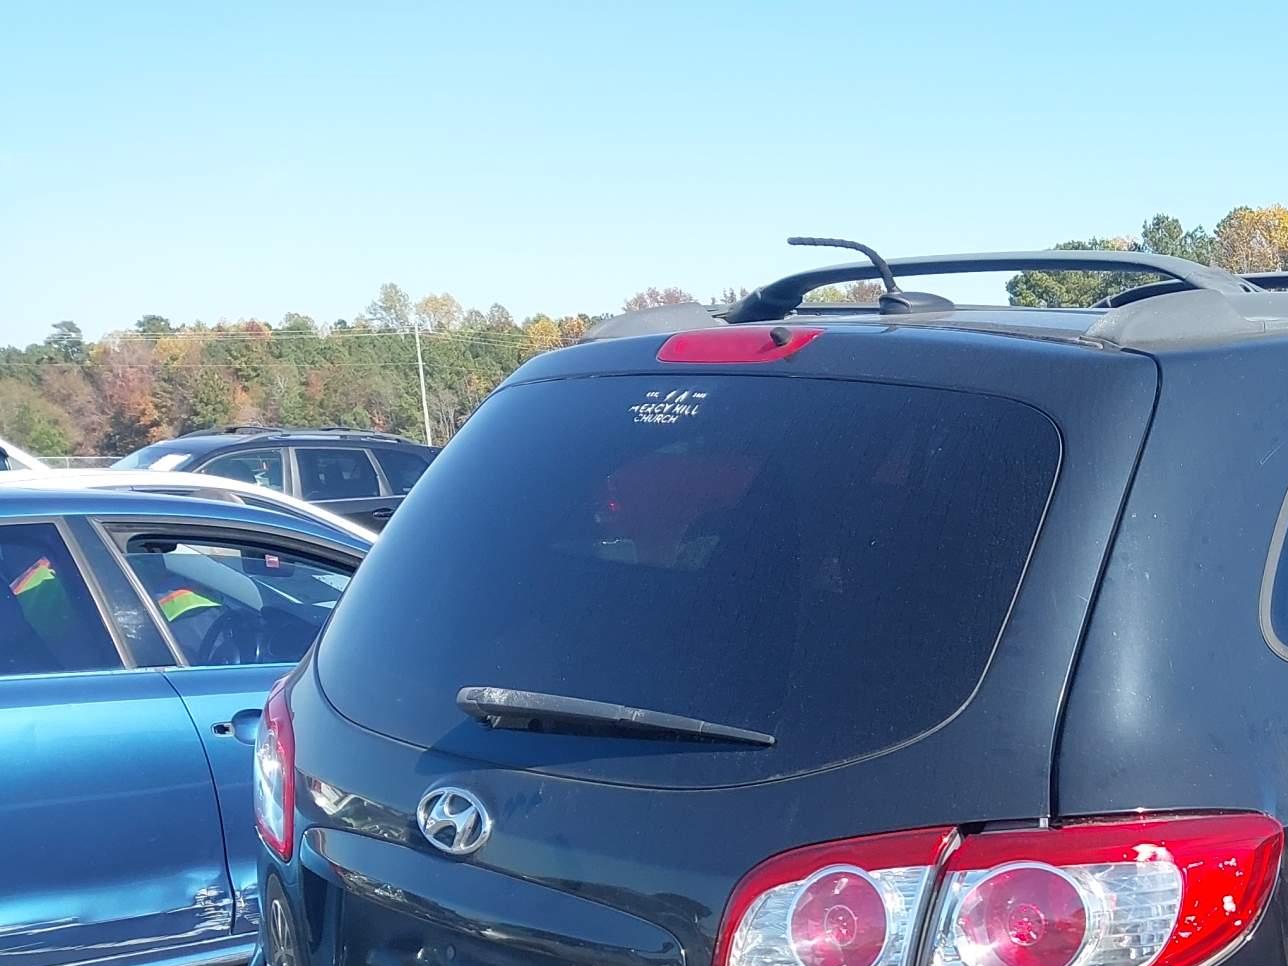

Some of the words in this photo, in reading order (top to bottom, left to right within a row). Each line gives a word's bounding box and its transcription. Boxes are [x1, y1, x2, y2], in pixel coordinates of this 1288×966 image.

[628, 403, 674, 413] MERCY
[672, 404, 700, 415] HILL
[633, 413, 679, 424] CHURCH
